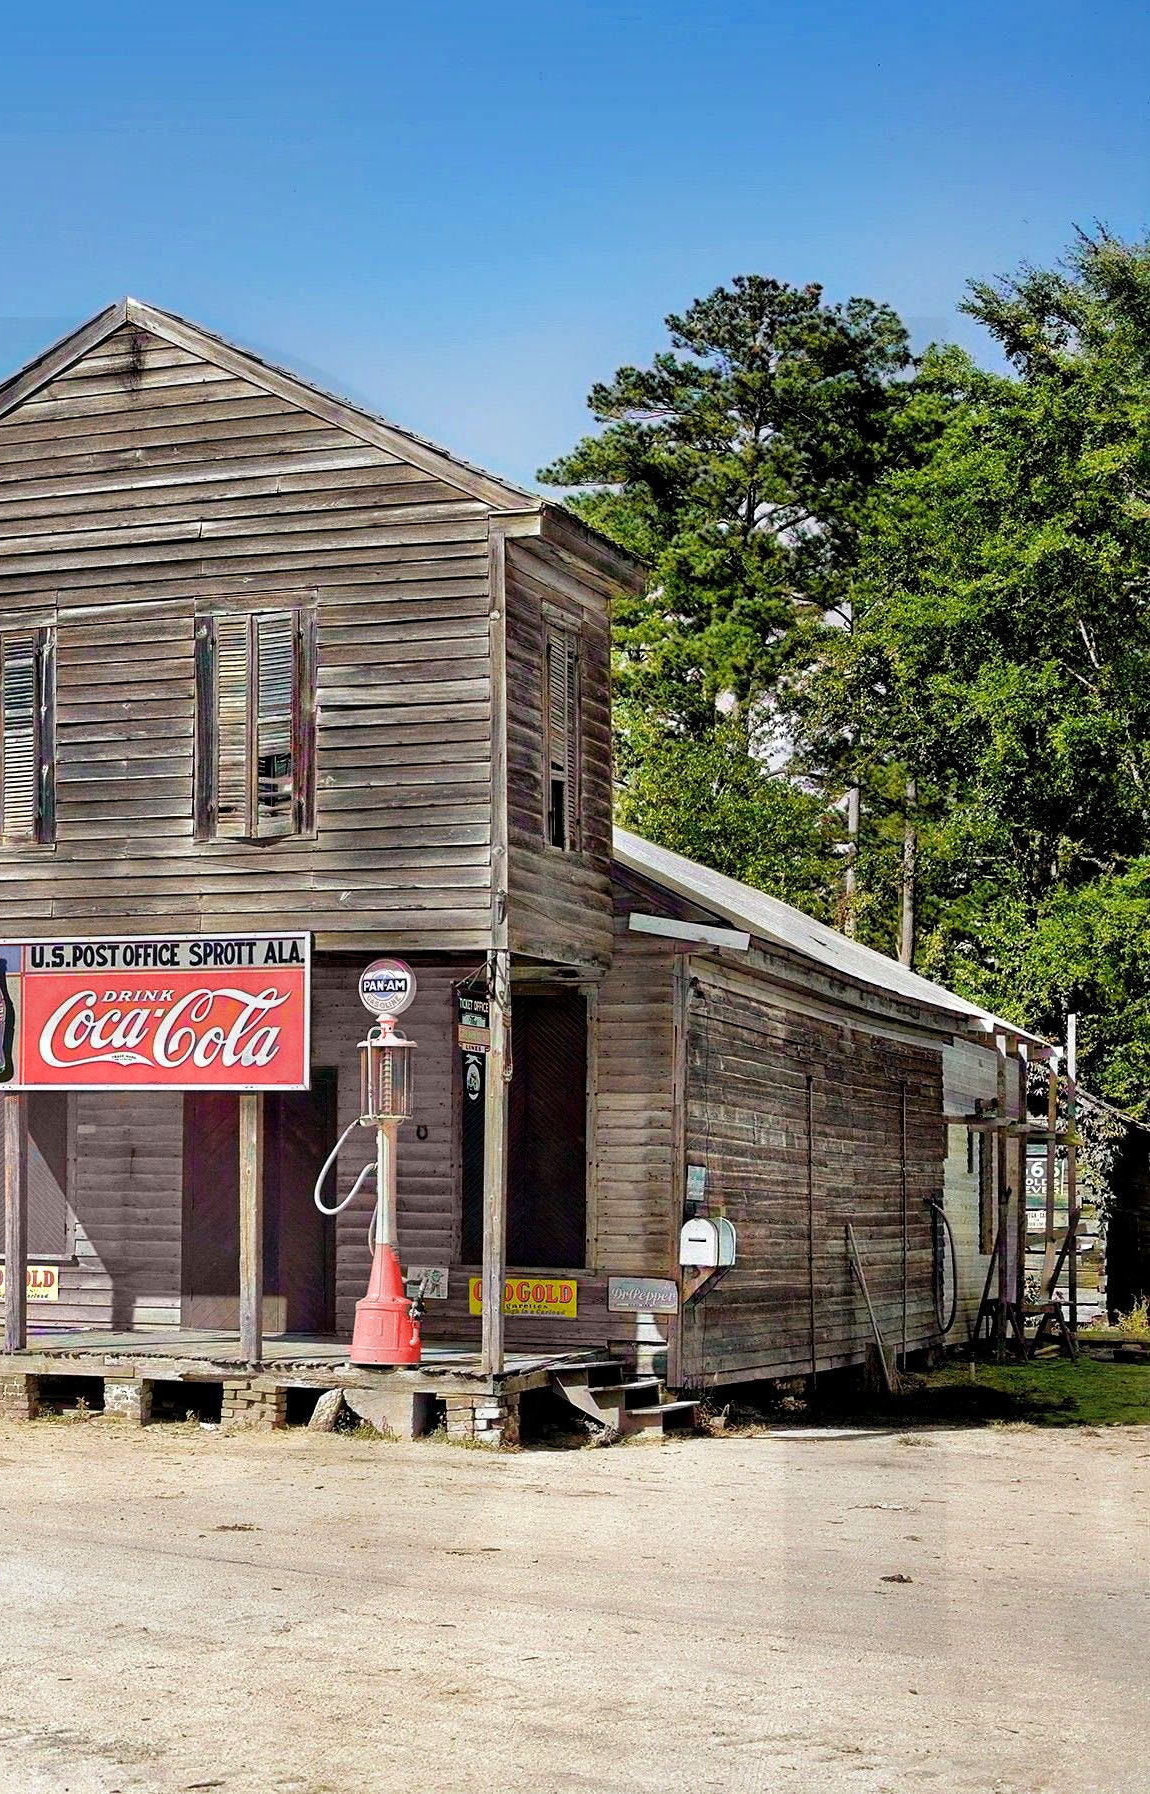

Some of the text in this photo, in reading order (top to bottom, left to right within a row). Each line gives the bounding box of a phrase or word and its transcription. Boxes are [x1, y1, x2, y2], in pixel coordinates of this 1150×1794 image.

[31, 941, 305, 968] U.S. POST OFFICE SPROTT ALA.
[363, 979, 406, 992] PAN-AM
[101, 989, 175, 1002] DRINK
[366, 994, 401, 1009] GASOLINE
[473, 1000, 489, 1013] OFFICE
[1026, 1178, 1061, 1186] OLDS
[1026, 1186, 1061, 1194] EVER
[26, 1270, 55, 1288] OLD
[473, 1280, 574, 1304] OD GOLD
[629, 1288, 676, 1306] Pepper
